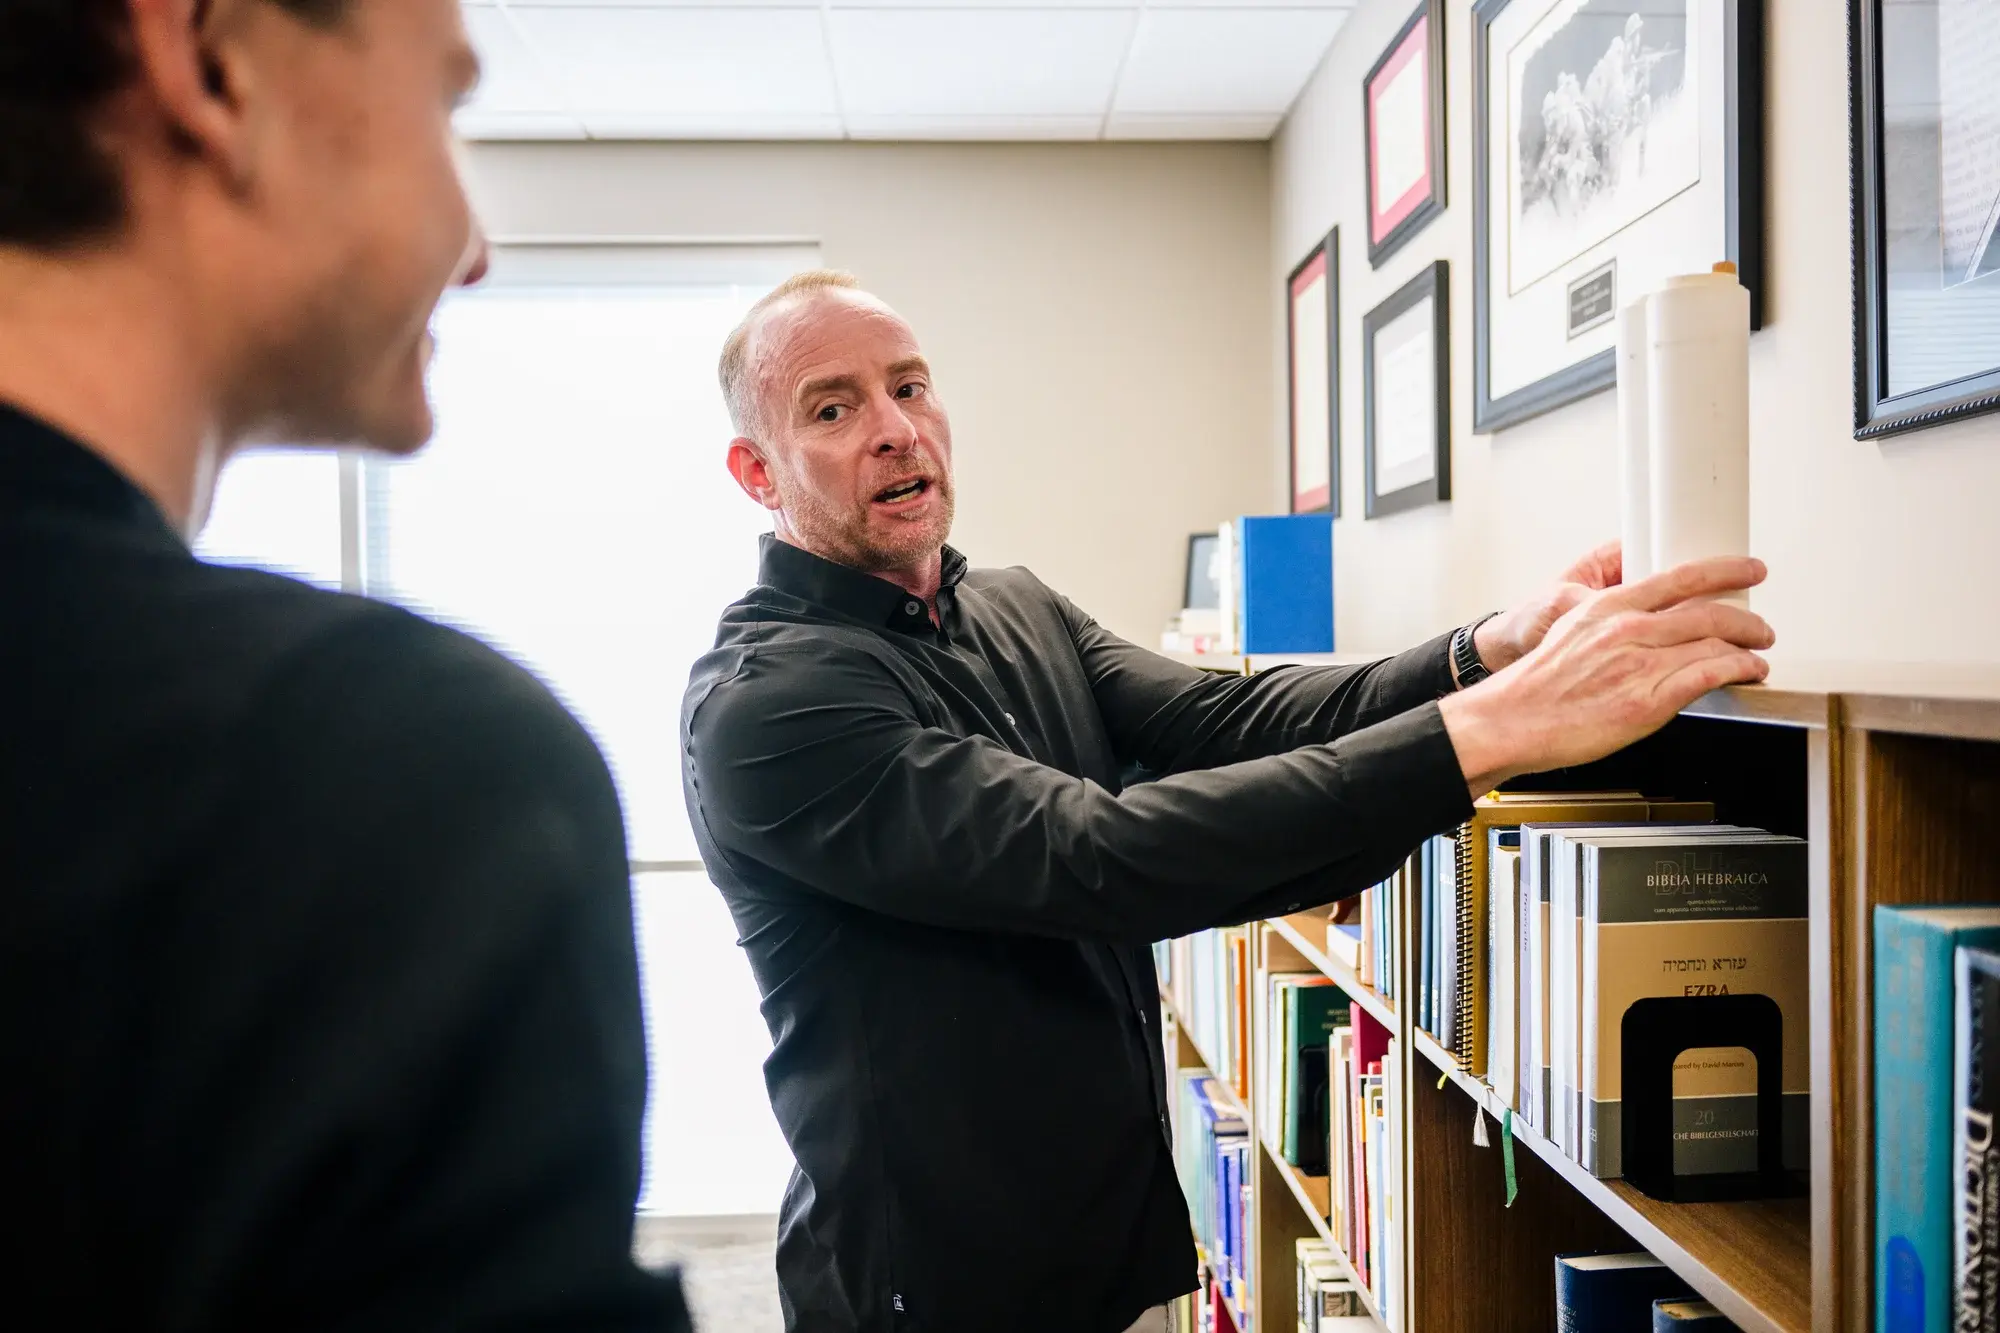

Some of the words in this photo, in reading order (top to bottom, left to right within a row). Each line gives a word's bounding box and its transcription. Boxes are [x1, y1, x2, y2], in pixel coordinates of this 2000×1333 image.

[1646, 874, 1691, 887] BIBLIA
[1696, 872, 1769, 885] HEBRAICA
[1663, 959, 1706, 972] ונחמיה
[1713, 957, 1747, 970] עזרא
[1683, 984, 1730, 997] EZRA
[1673, 1062, 1691, 1070] pared
[1722, 1060, 1744, 1068] Marcus
[1695, 1109, 1714, 1125] 20
[1673, 1131, 1689, 1140] CHE
[1963, 1106, 1992, 1333] DICTIONAR
